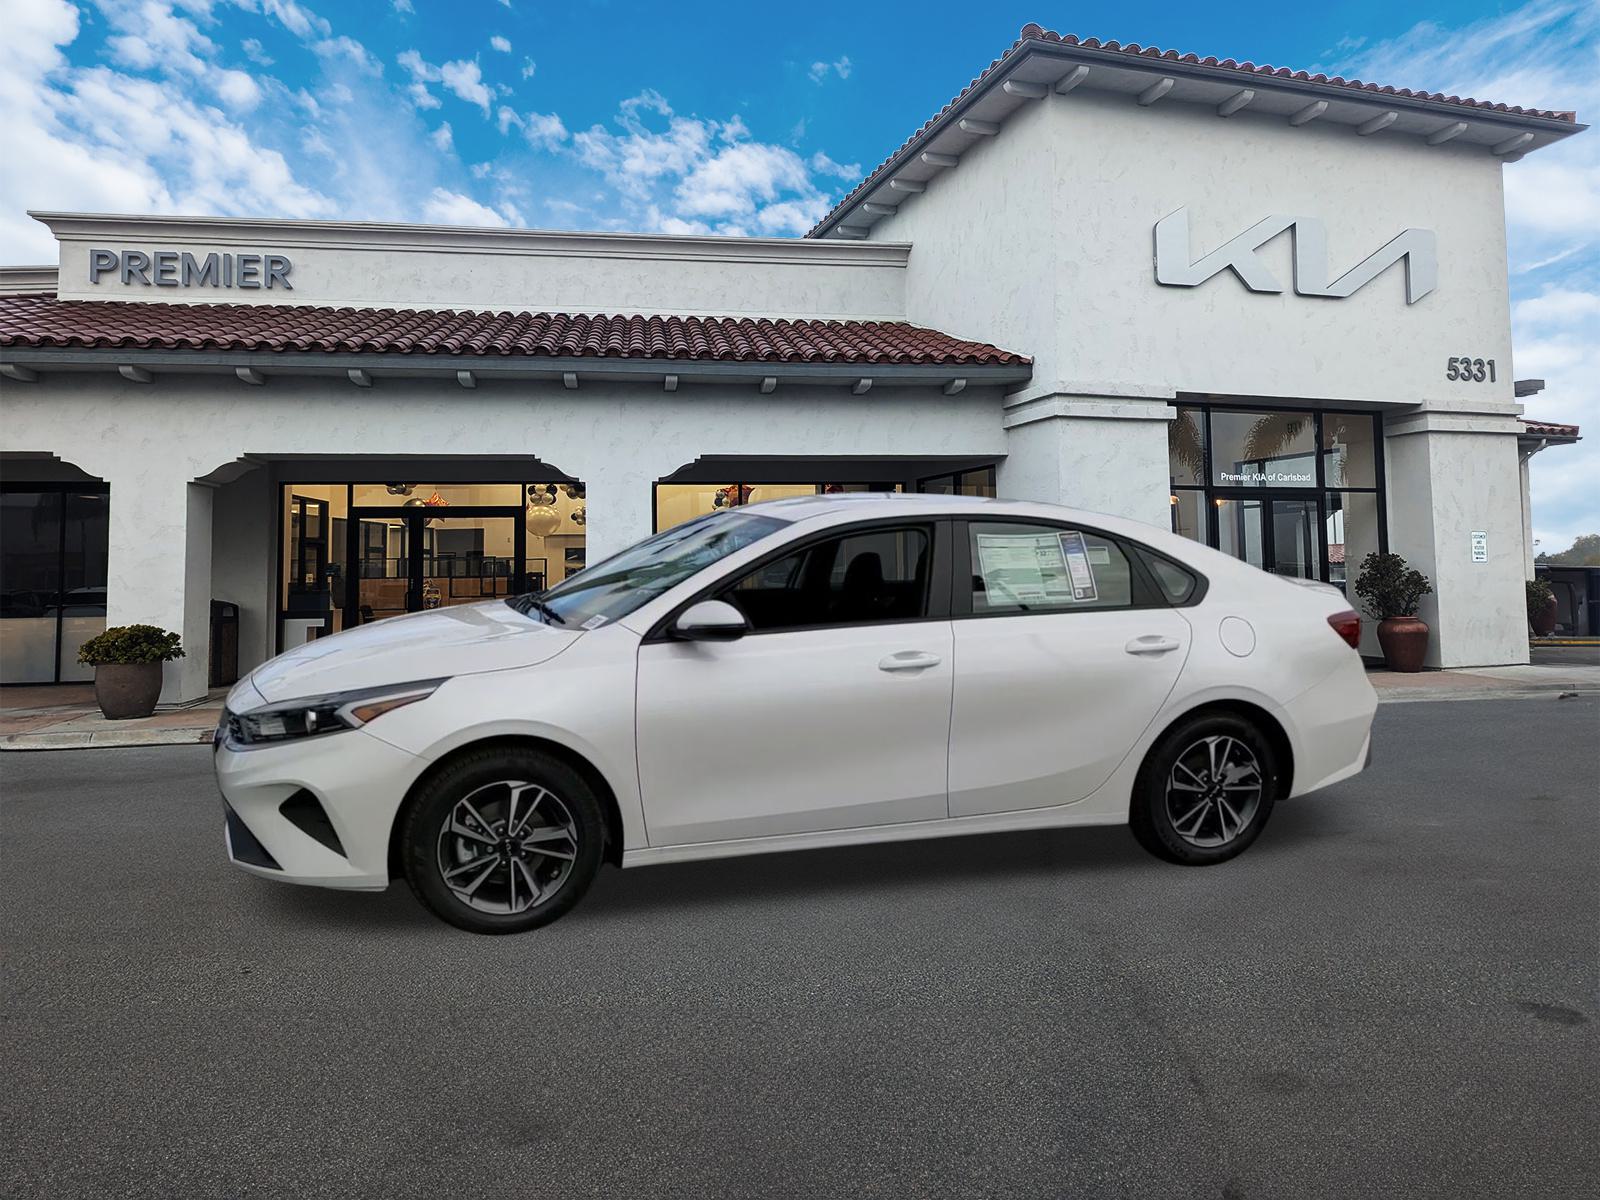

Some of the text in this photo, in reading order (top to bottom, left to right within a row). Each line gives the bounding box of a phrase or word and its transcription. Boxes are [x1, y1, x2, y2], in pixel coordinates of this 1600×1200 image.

[89, 249, 294, 290] PREMIER
[1152, 205, 1437, 305] KIA
[1446, 356, 1497, 383] 5331
[1220, 472, 1311, 482] Premier KIA of Carlsbad
